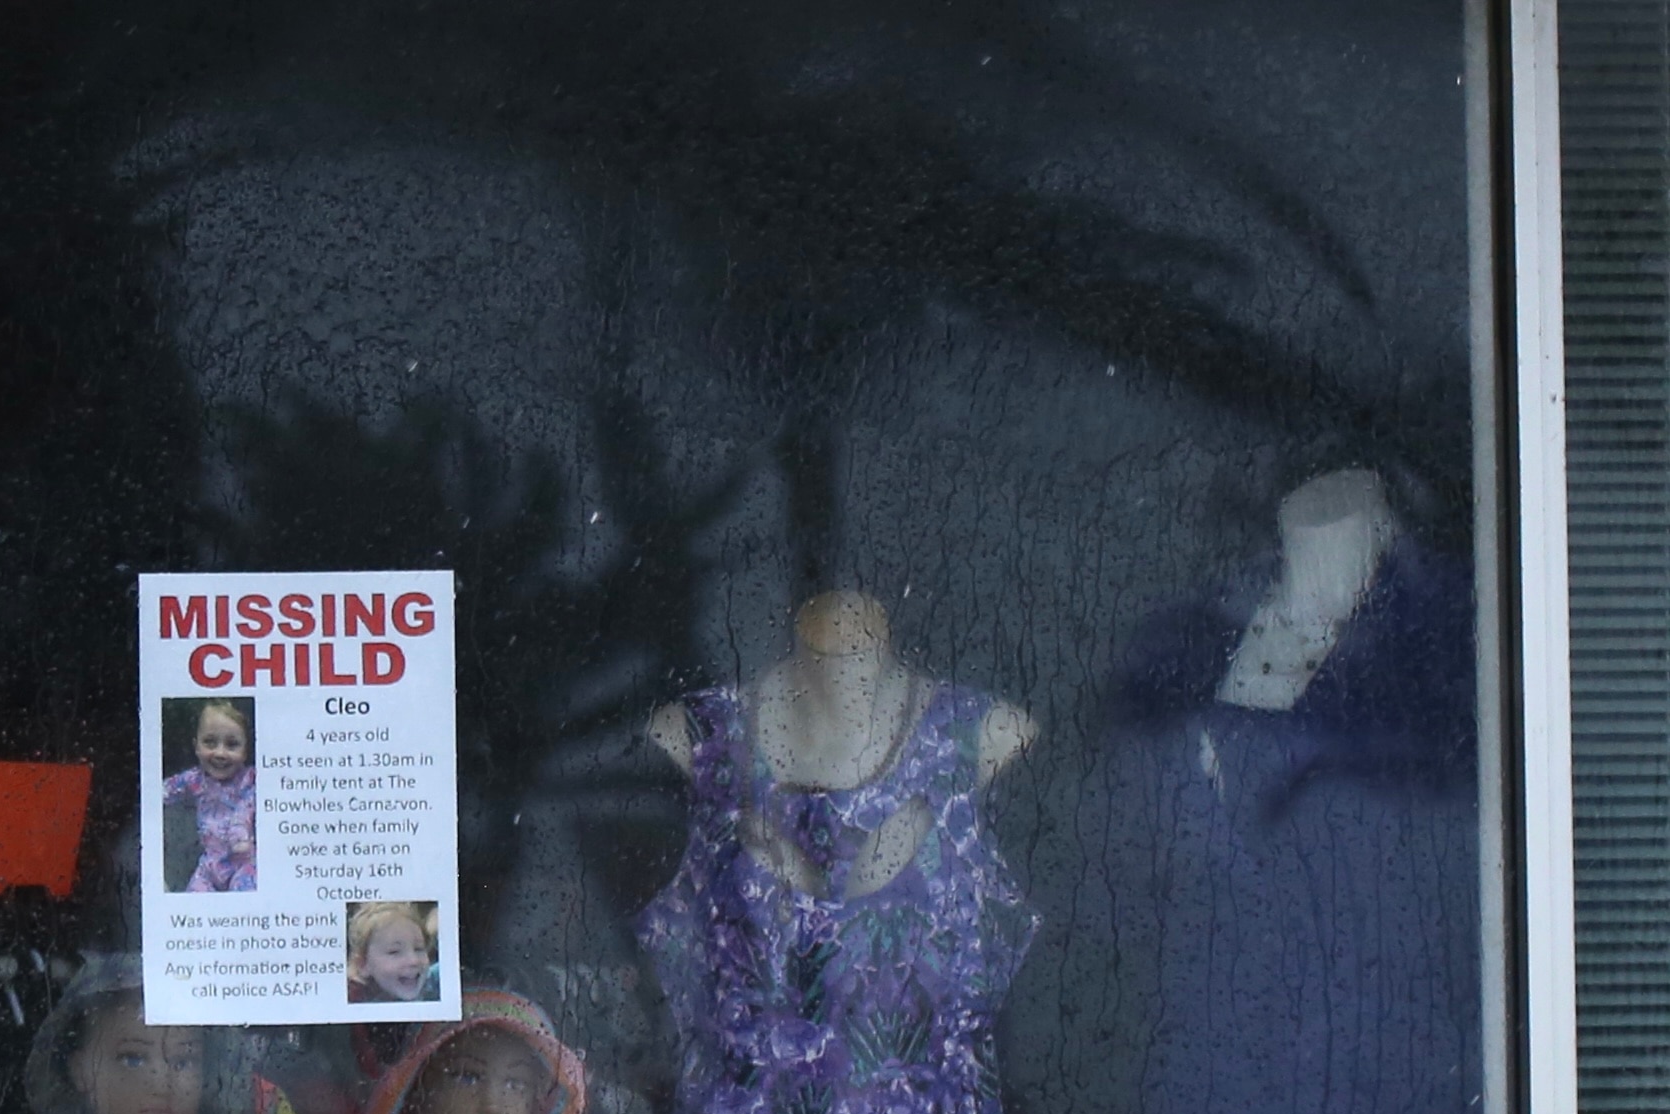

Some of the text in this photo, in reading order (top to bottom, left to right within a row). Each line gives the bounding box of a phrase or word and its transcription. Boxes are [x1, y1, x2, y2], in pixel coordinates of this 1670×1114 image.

[159, 592, 435, 639] MISSING
[189, 642, 405, 688] CHILD
[325, 697, 370, 715] Cleo
[306, 726, 390, 746] 4 years old
[262, 752, 434, 769] Last seen at 1.30am in
[280, 774, 417, 793] family tent at The
[263, 796, 432, 813] Blowholes Carnarvon.
[278, 818, 419, 836] Gone when family
[288, 841, 411, 857] woke at 6am on
[295, 862, 403, 881] Saturday 16th
[316, 885, 382, 901] October.
[170, 911, 338, 931] Was wearing the pink
[165, 934, 342, 953] onesie in photo above.
[164, 959, 344, 979] Any information please
[191, 982, 218, 998] call
[221, 982, 268, 1001] police
